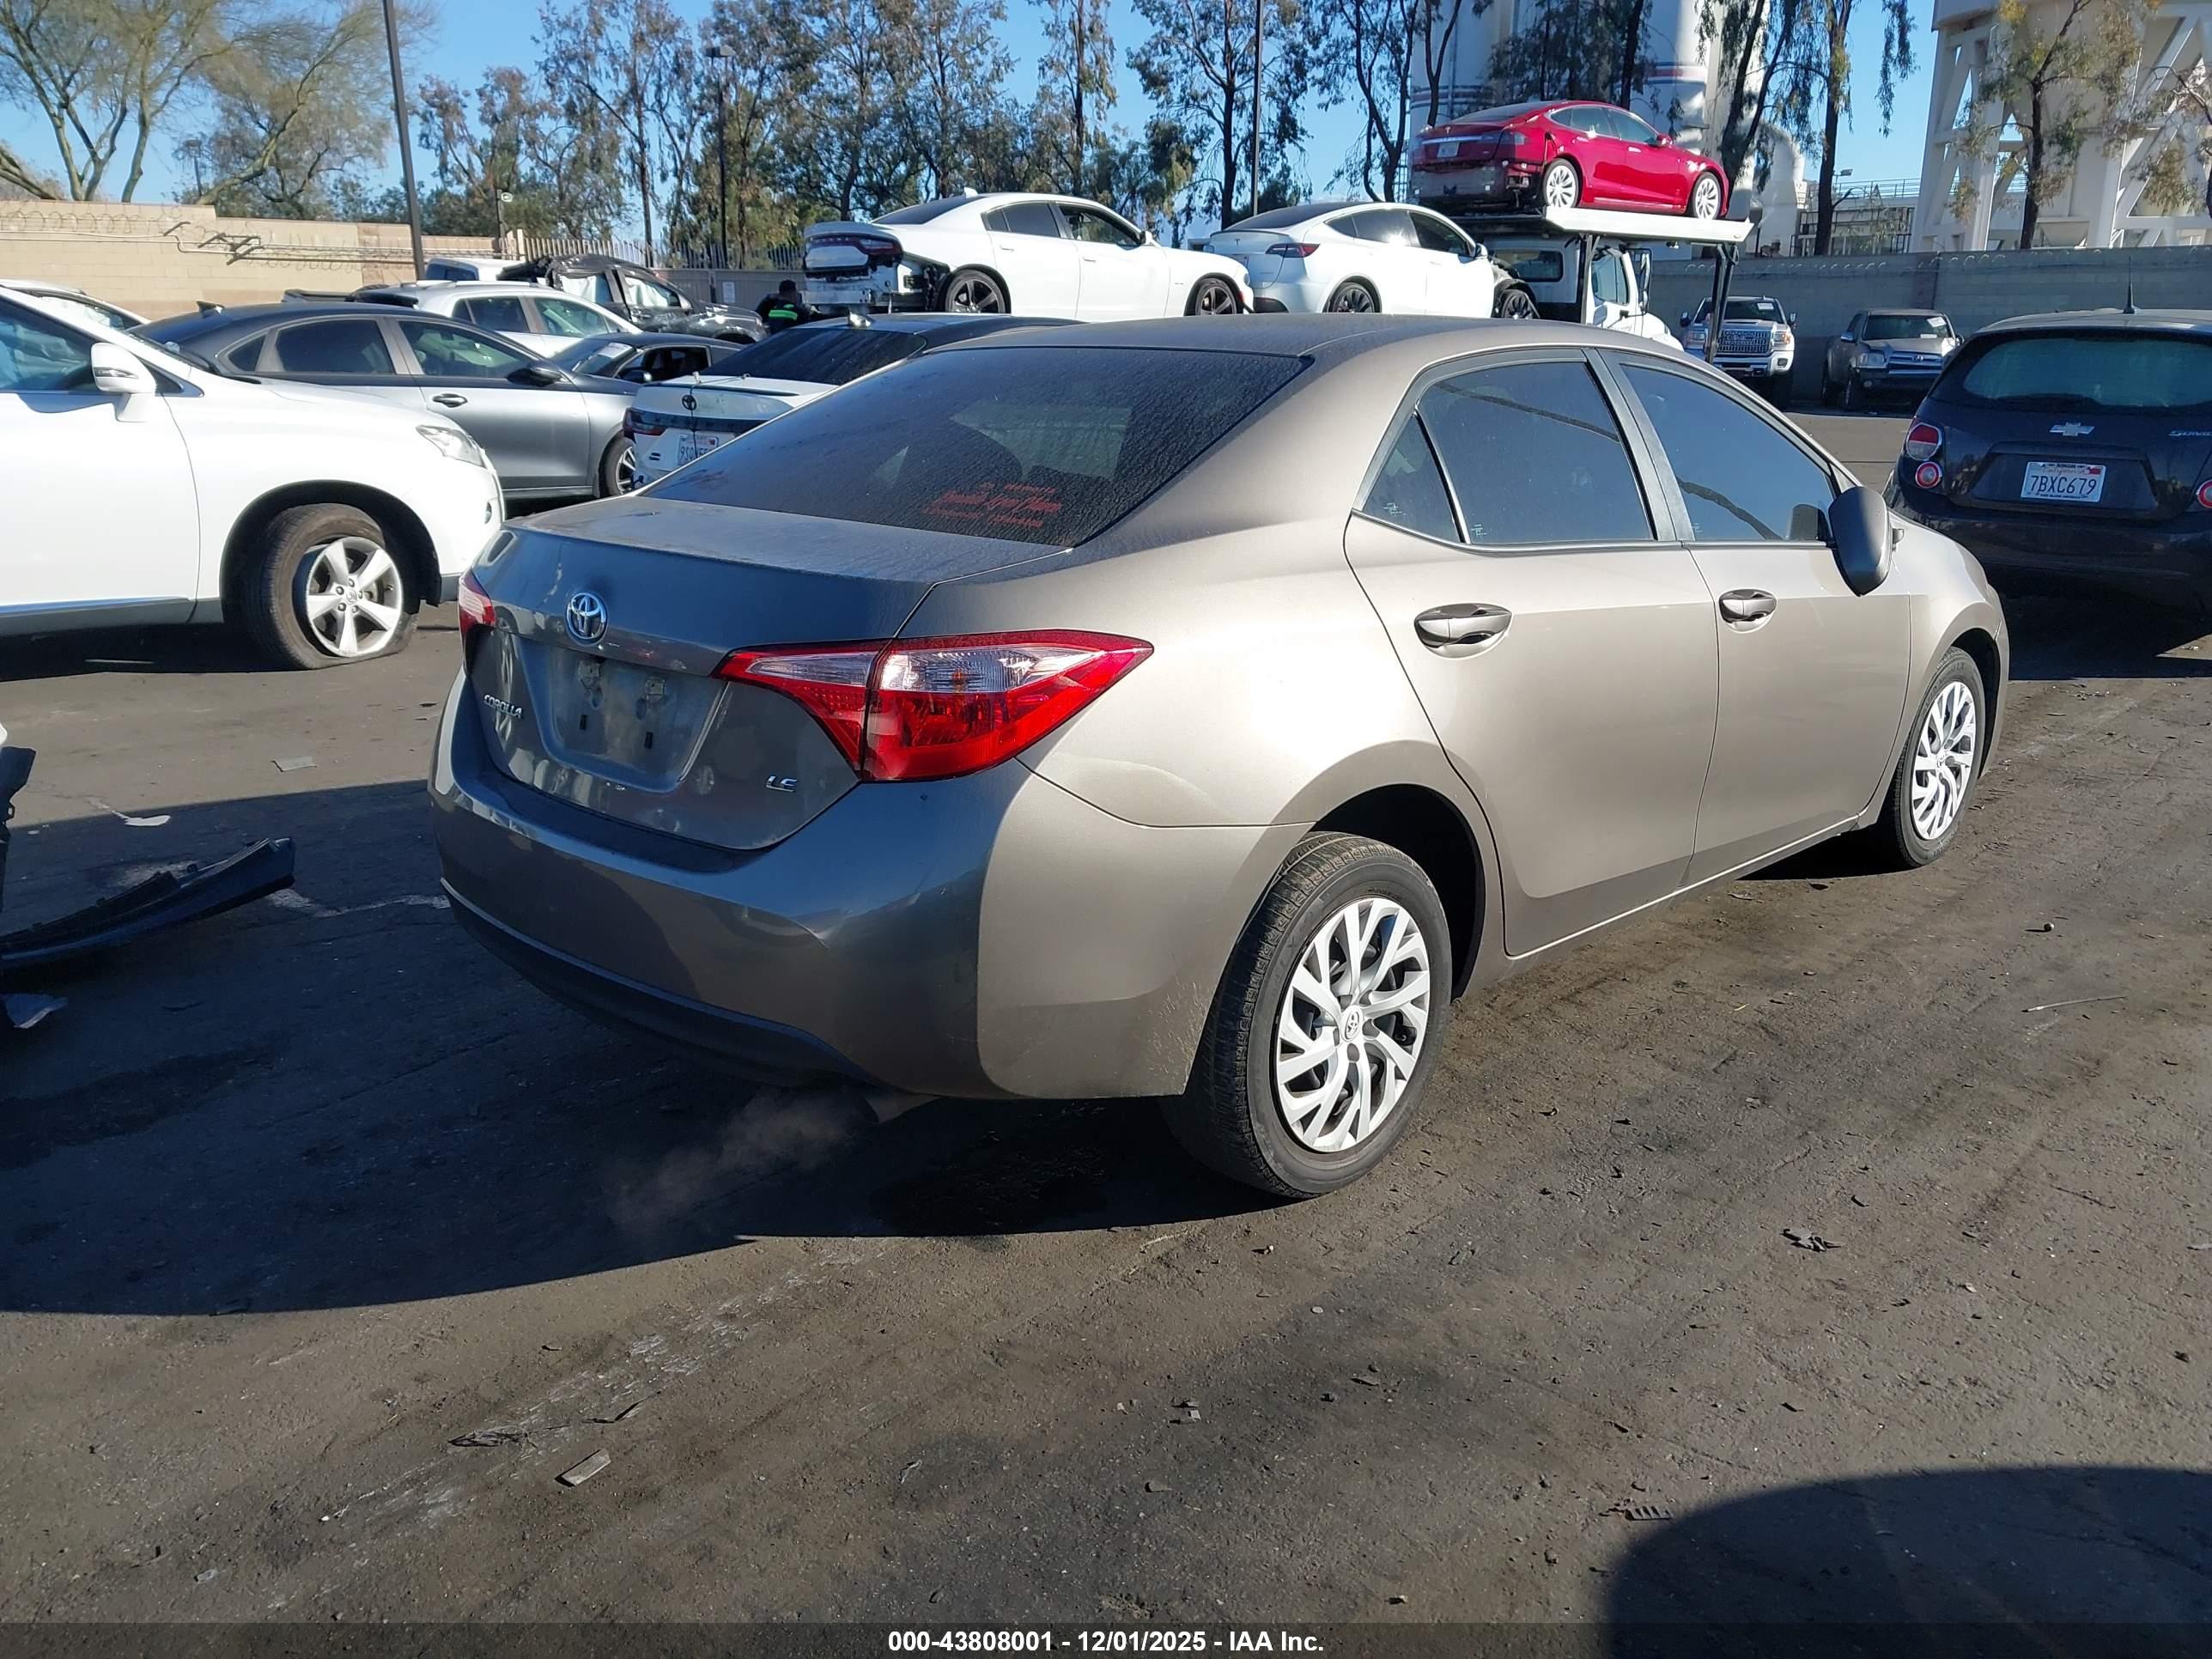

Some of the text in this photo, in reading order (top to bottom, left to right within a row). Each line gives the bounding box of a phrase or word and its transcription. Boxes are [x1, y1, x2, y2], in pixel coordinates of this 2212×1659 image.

[2030, 475, 2097, 495] 7BXC679
[483, 694, 523, 720] COROLLA
[765, 775, 798, 793] LE
